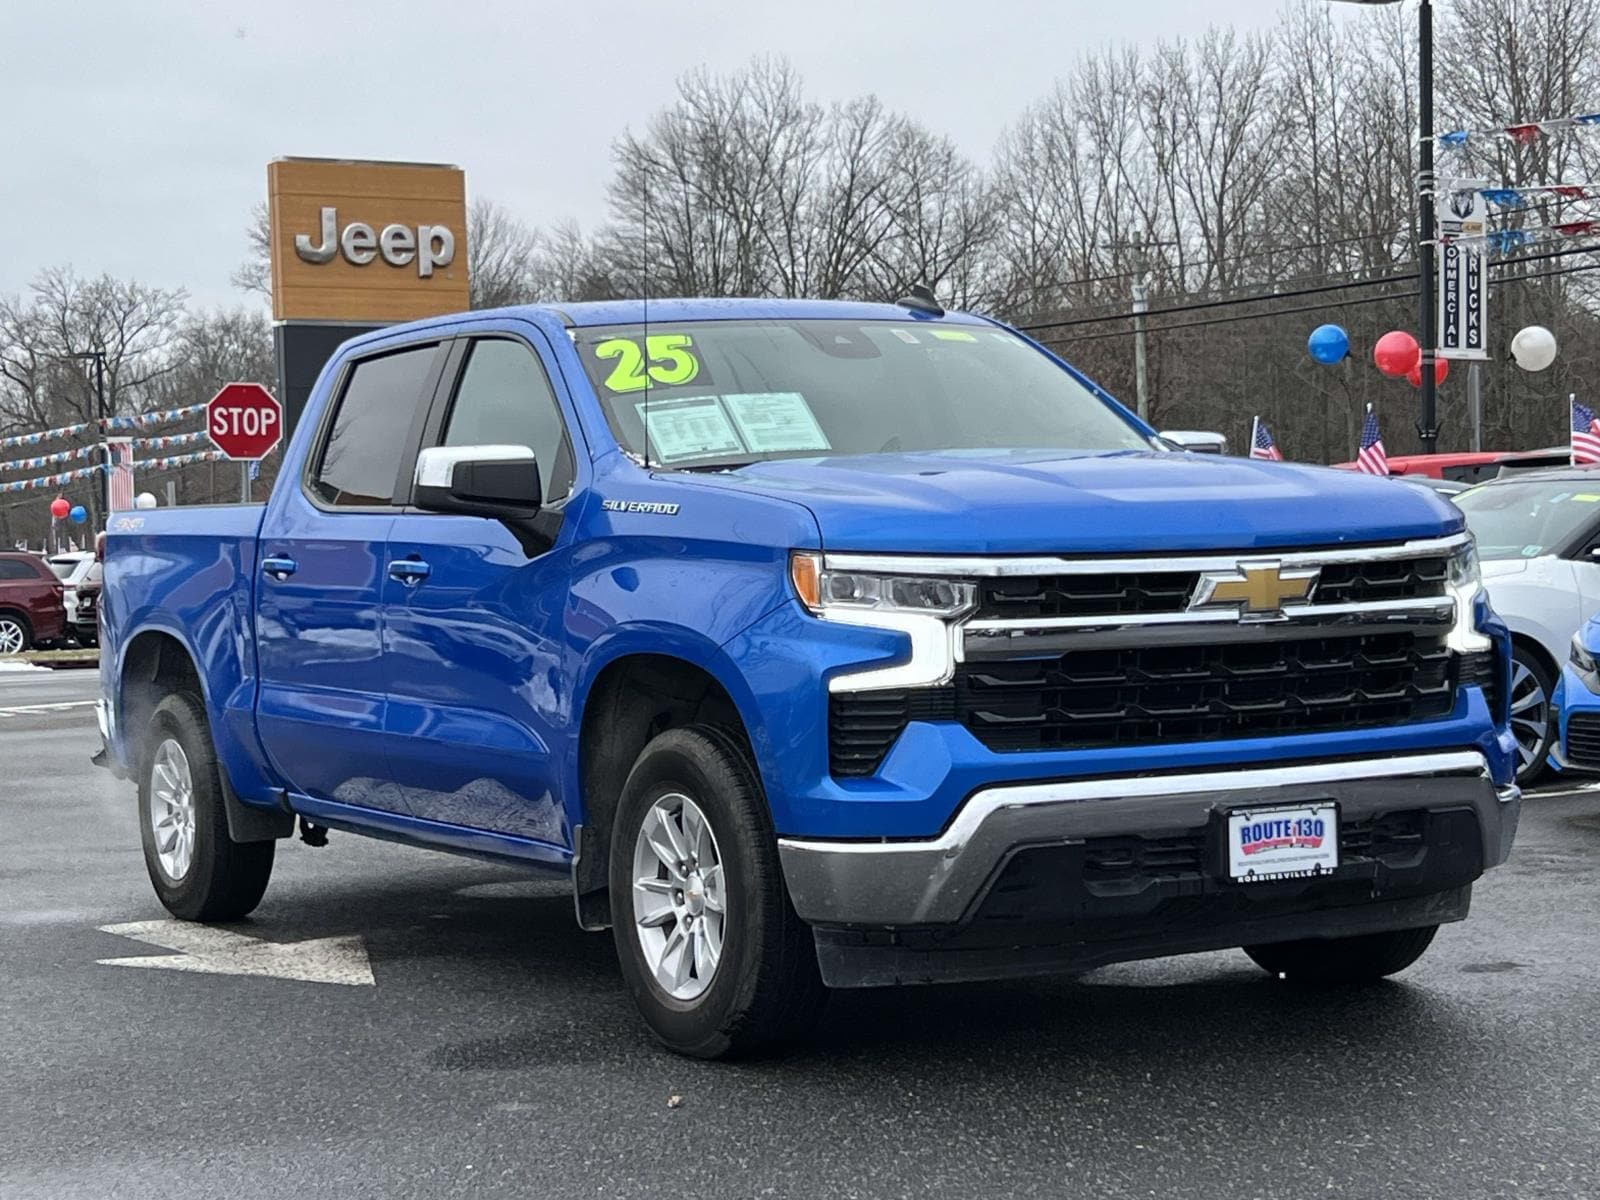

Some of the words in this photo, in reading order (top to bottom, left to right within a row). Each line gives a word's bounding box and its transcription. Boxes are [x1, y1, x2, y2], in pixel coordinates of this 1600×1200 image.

[295, 206, 456, 278] Jeep
[1468, 256, 1479, 345] RUCKS
[595, 335, 699, 393] 25
[213, 406, 277, 436] STOP
[601, 500, 680, 515] SILVERADO
[1240, 819, 1292, 845] ROUTE
[1295, 817, 1325, 838] 130
